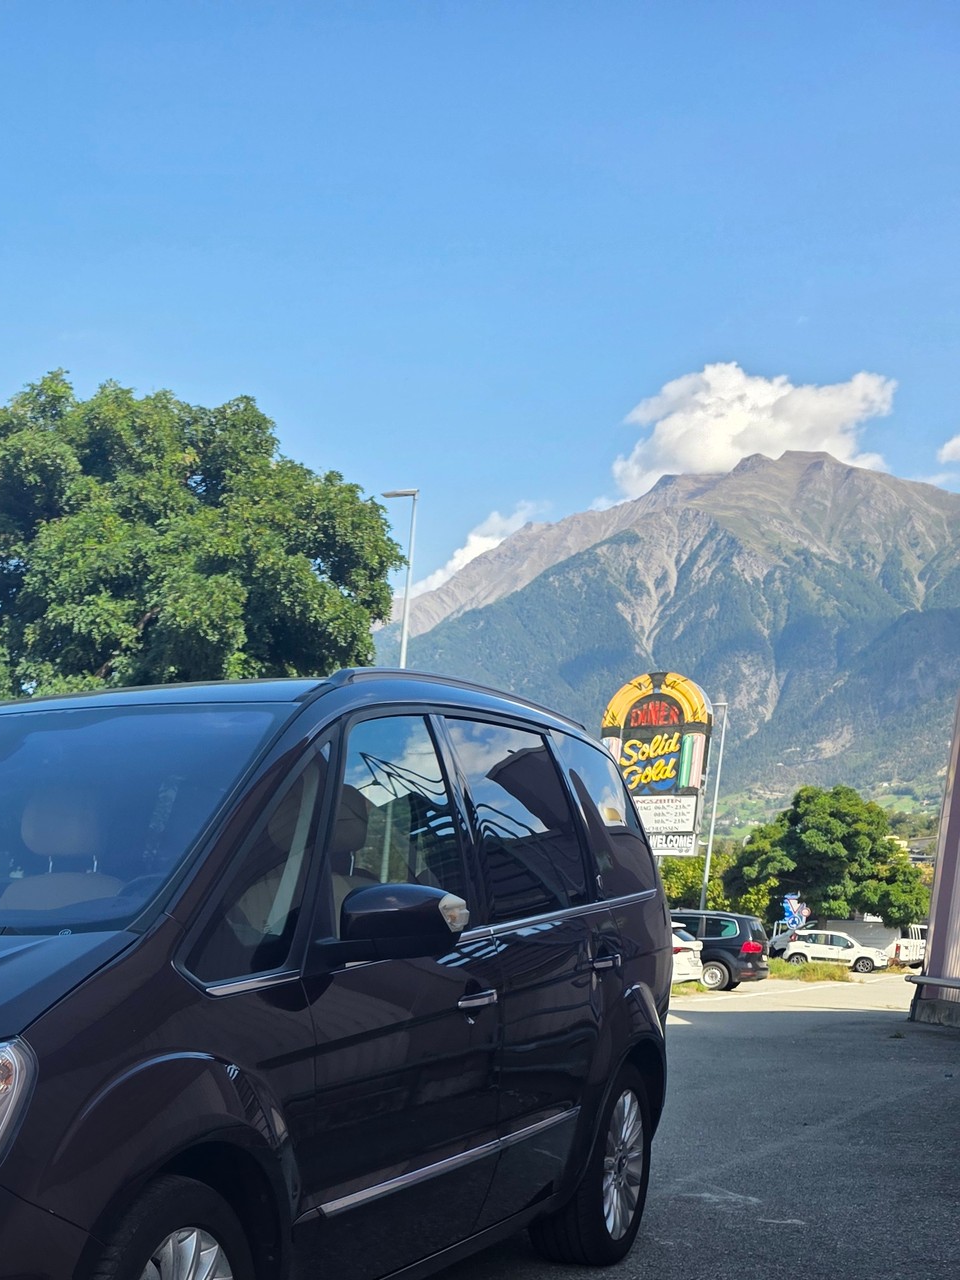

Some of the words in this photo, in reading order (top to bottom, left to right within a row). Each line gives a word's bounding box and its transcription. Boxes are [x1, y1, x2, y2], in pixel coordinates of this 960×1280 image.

[630, 701, 680, 727] DINER
[620, 732, 680, 766] Solid
[623, 758, 676, 790] Gold
[649, 834, 693, 849] WELCOME
